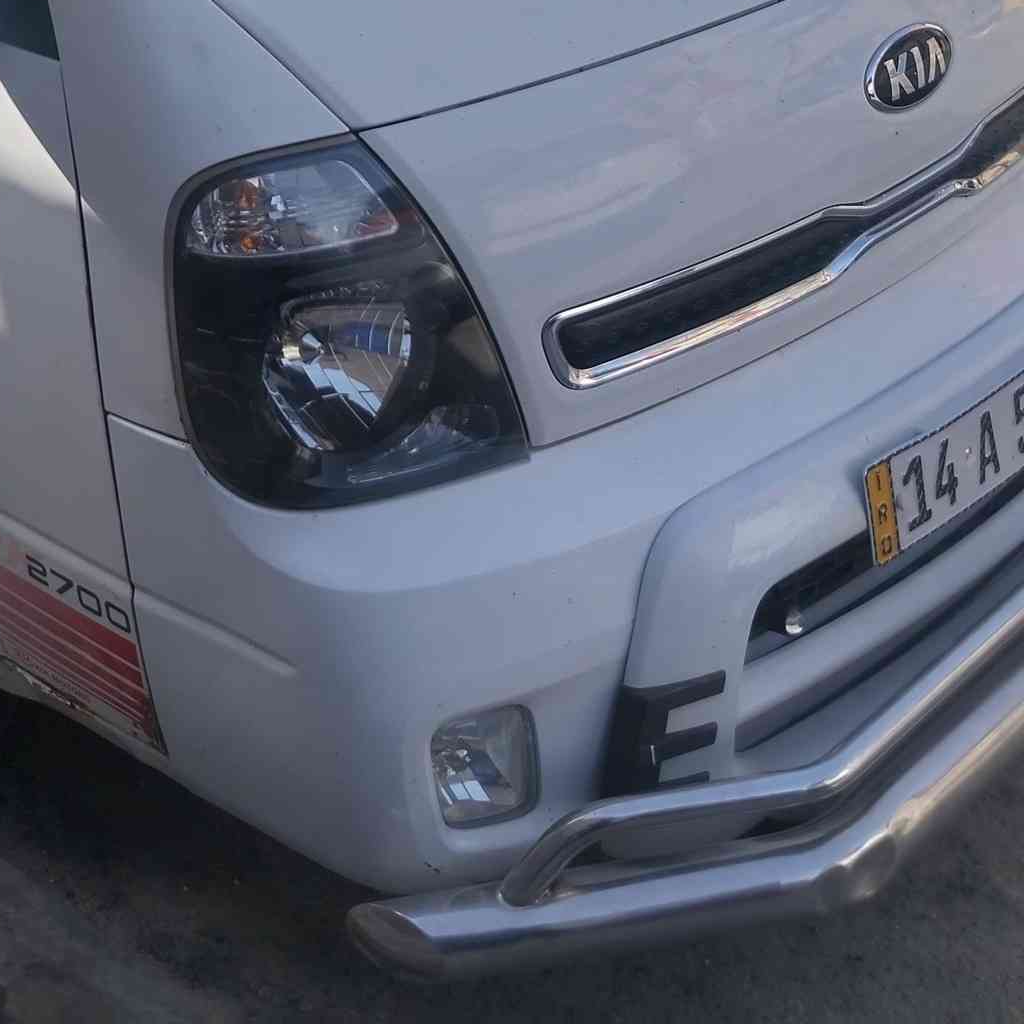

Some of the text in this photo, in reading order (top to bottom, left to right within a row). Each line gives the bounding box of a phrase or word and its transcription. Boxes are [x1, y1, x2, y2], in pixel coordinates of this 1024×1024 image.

[884, 36, 946, 101] KIA
[902, 437, 959, 532] 14
[979, 410, 1001, 485] A
[26, 554, 131, 633] 2700
